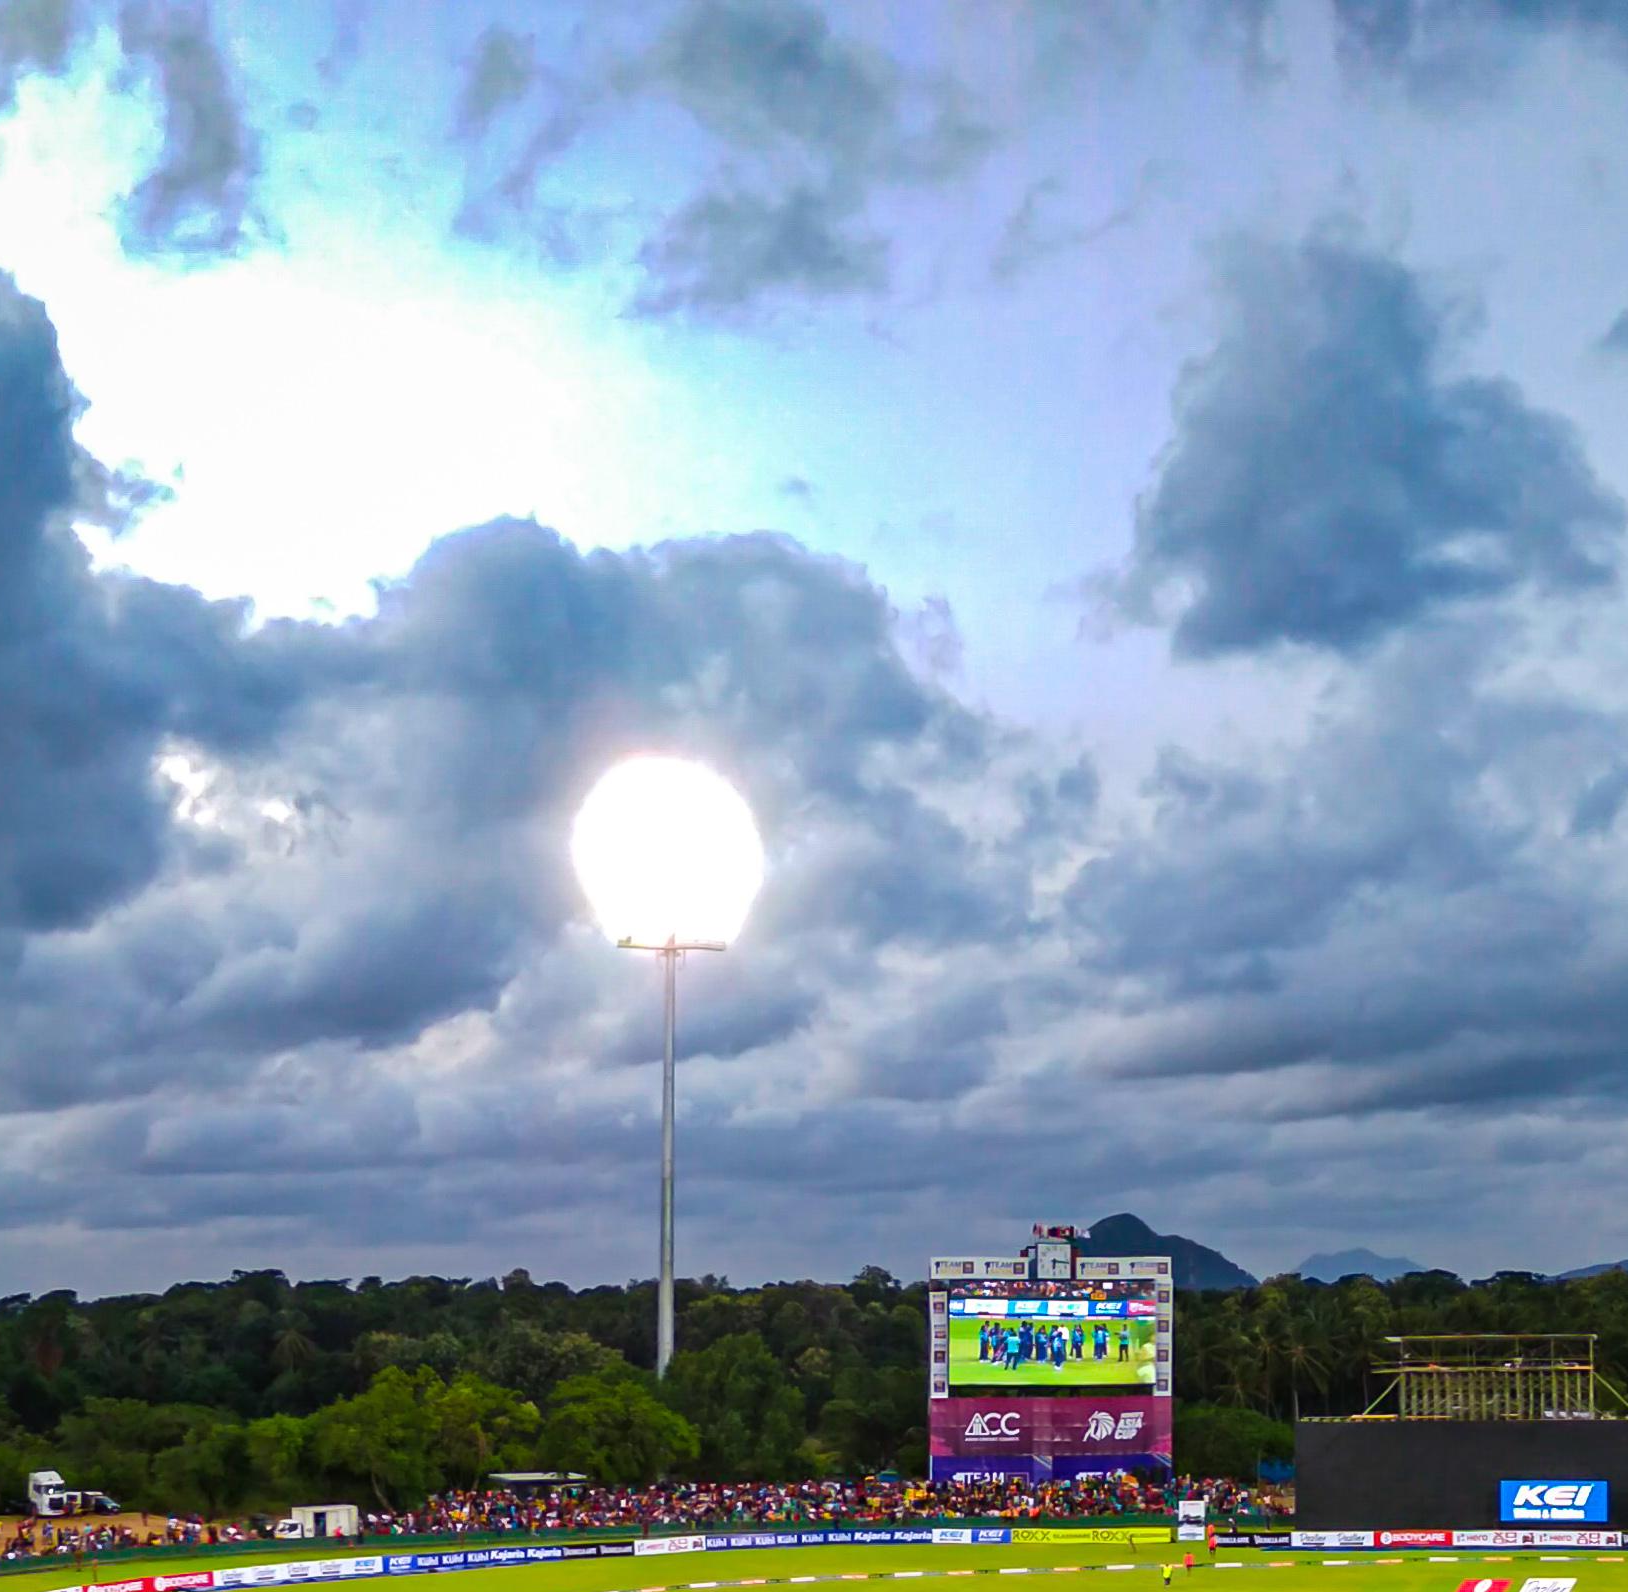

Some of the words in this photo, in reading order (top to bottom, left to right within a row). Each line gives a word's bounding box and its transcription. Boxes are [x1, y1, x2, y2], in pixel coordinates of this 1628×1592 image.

[1095, 1302, 1123, 1311] KEI
[964, 1412, 1021, 1436] ACC
[1512, 1484, 1594, 1506] KEI
[854, 1531, 892, 1542] Kajaria
[894, 1530, 933, 1541] Kajaria
[939, 1530, 964, 1538] KEI
[978, 1529, 1004, 1538] KEI
[1012, 1529, 1051, 1541] ROXX
[1392, 1533, 1446, 1542] BODYCARE
